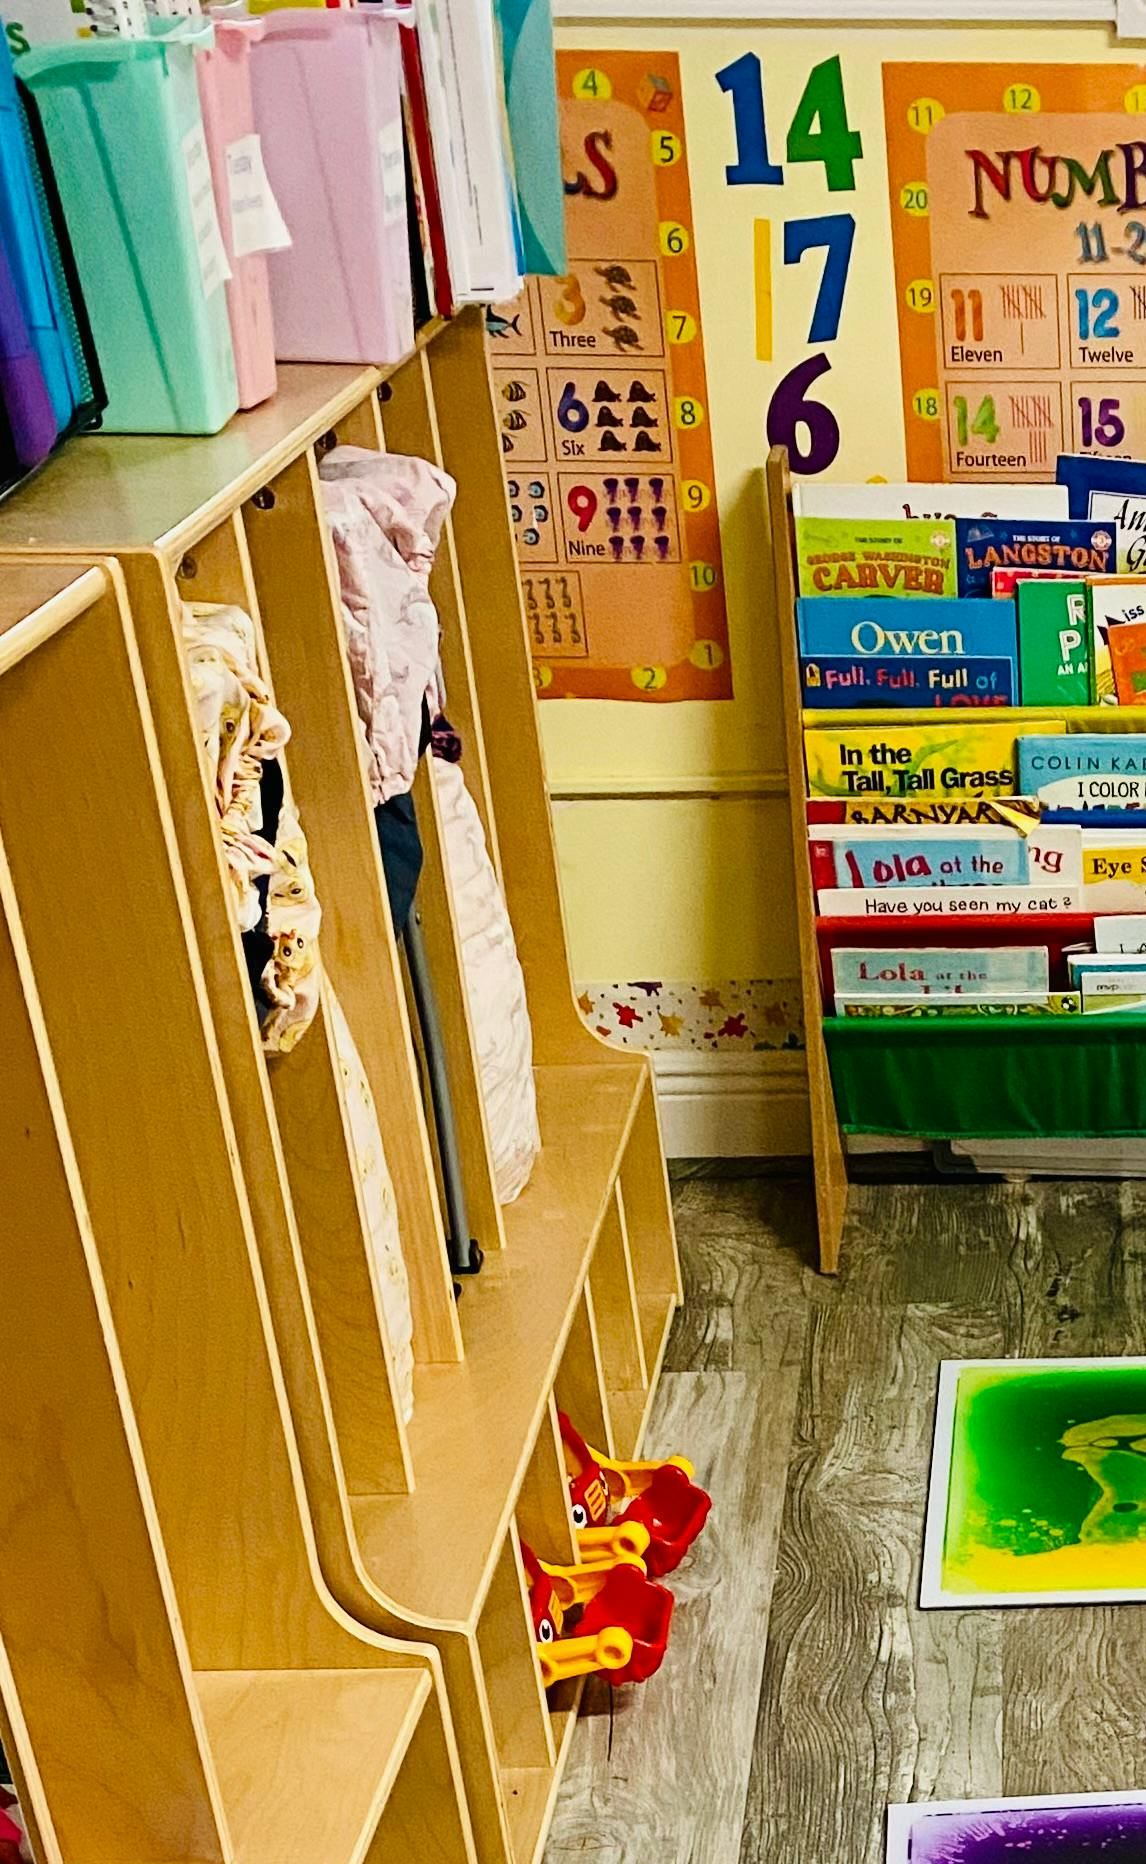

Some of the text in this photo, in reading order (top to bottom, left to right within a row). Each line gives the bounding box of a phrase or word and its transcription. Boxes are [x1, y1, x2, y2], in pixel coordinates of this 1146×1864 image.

[582, 70, 598, 97] 4
[1008, 88, 1033, 110] 12
[715, 52, 863, 192] 14
[911, 104, 934, 127] 11
[660, 136, 674, 163] 5
[903, 188, 928, 209] 20
[667, 228, 683, 253] 6
[554, 275, 586, 326] 3
[908, 287, 932, 307] 19
[951, 288, 984, 341] 11
[1075, 288, 1120, 341] 12
[672, 315, 687, 339] 7
[549, 330, 597, 348] Three
[951, 346, 1003, 363] Eleven
[1079, 346, 1134, 364] Twelve
[557, 382, 589, 432] 6
[680, 400, 696, 425] 8
[766, 352, 840, 476] 6
[915, 396, 937, 416] 18
[953, 394, 1000, 446] 14
[1078, 396, 1125, 447] 15
[562, 439, 585, 456] Six
[956, 451, 1027, 468] Fourteen
[687, 484, 702, 509] 9
[567, 485, 598, 532] 9
[569, 540, 606, 557] Nine
[806, 551, 856, 567] GEORGE
[965, 543, 1110, 574] LANGSTON
[693, 564, 716, 586] 10
[812, 562, 945, 595] CARVER
[851, 620, 966, 656] Owen
[704, 643, 713, 665] 1
[644, 667, 656, 690] 2
[928, 667, 968, 690] Full
[976, 671, 998, 690] of
[1057, 664, 1074, 676] AN
[839, 743, 912, 766] In the
[1031, 755, 1100, 771] COLIN
[842, 767, 1014, 795] Tall, Tall Grass
[1077, 781, 1084, 798] I
[1089, 781, 1139, 798] COLOR
[850, 801, 996, 825] BARNYAR
[845, 850, 1004, 889] Lola at the
[1092, 857, 1132, 878] Eye
[865, 898, 909, 914] Have
[913, 899, 943, 916] you
[949, 898, 989, 912] seen
[997, 899, 1020, 914] my
[1028, 897, 1058, 910] cat
[858, 961, 988, 981] Lola at the
